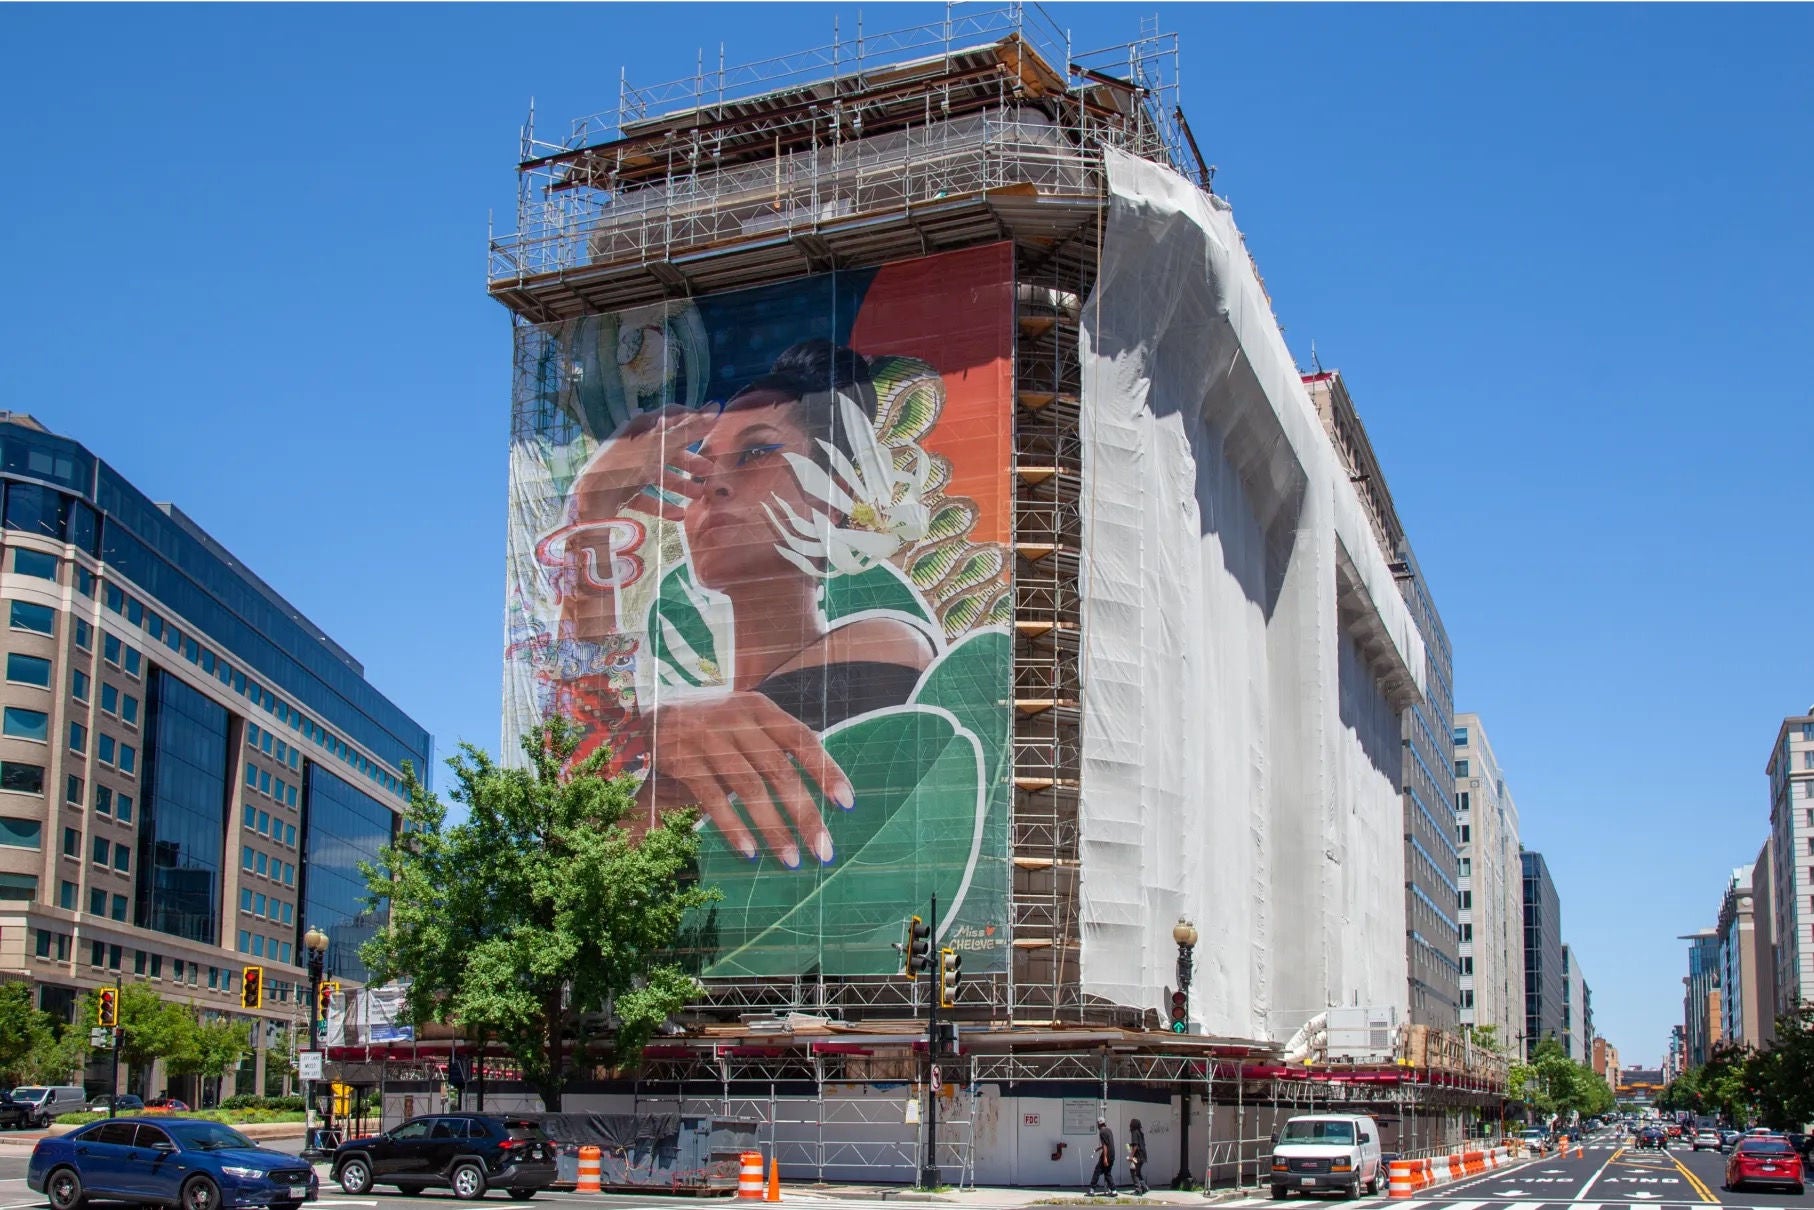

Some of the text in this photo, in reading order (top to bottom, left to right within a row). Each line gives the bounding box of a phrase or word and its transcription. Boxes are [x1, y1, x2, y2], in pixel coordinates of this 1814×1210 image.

[953, 925, 985, 938] Miss
[949, 939, 994, 950] CHELOVE
[1025, 1116, 1038, 1124] FDC
